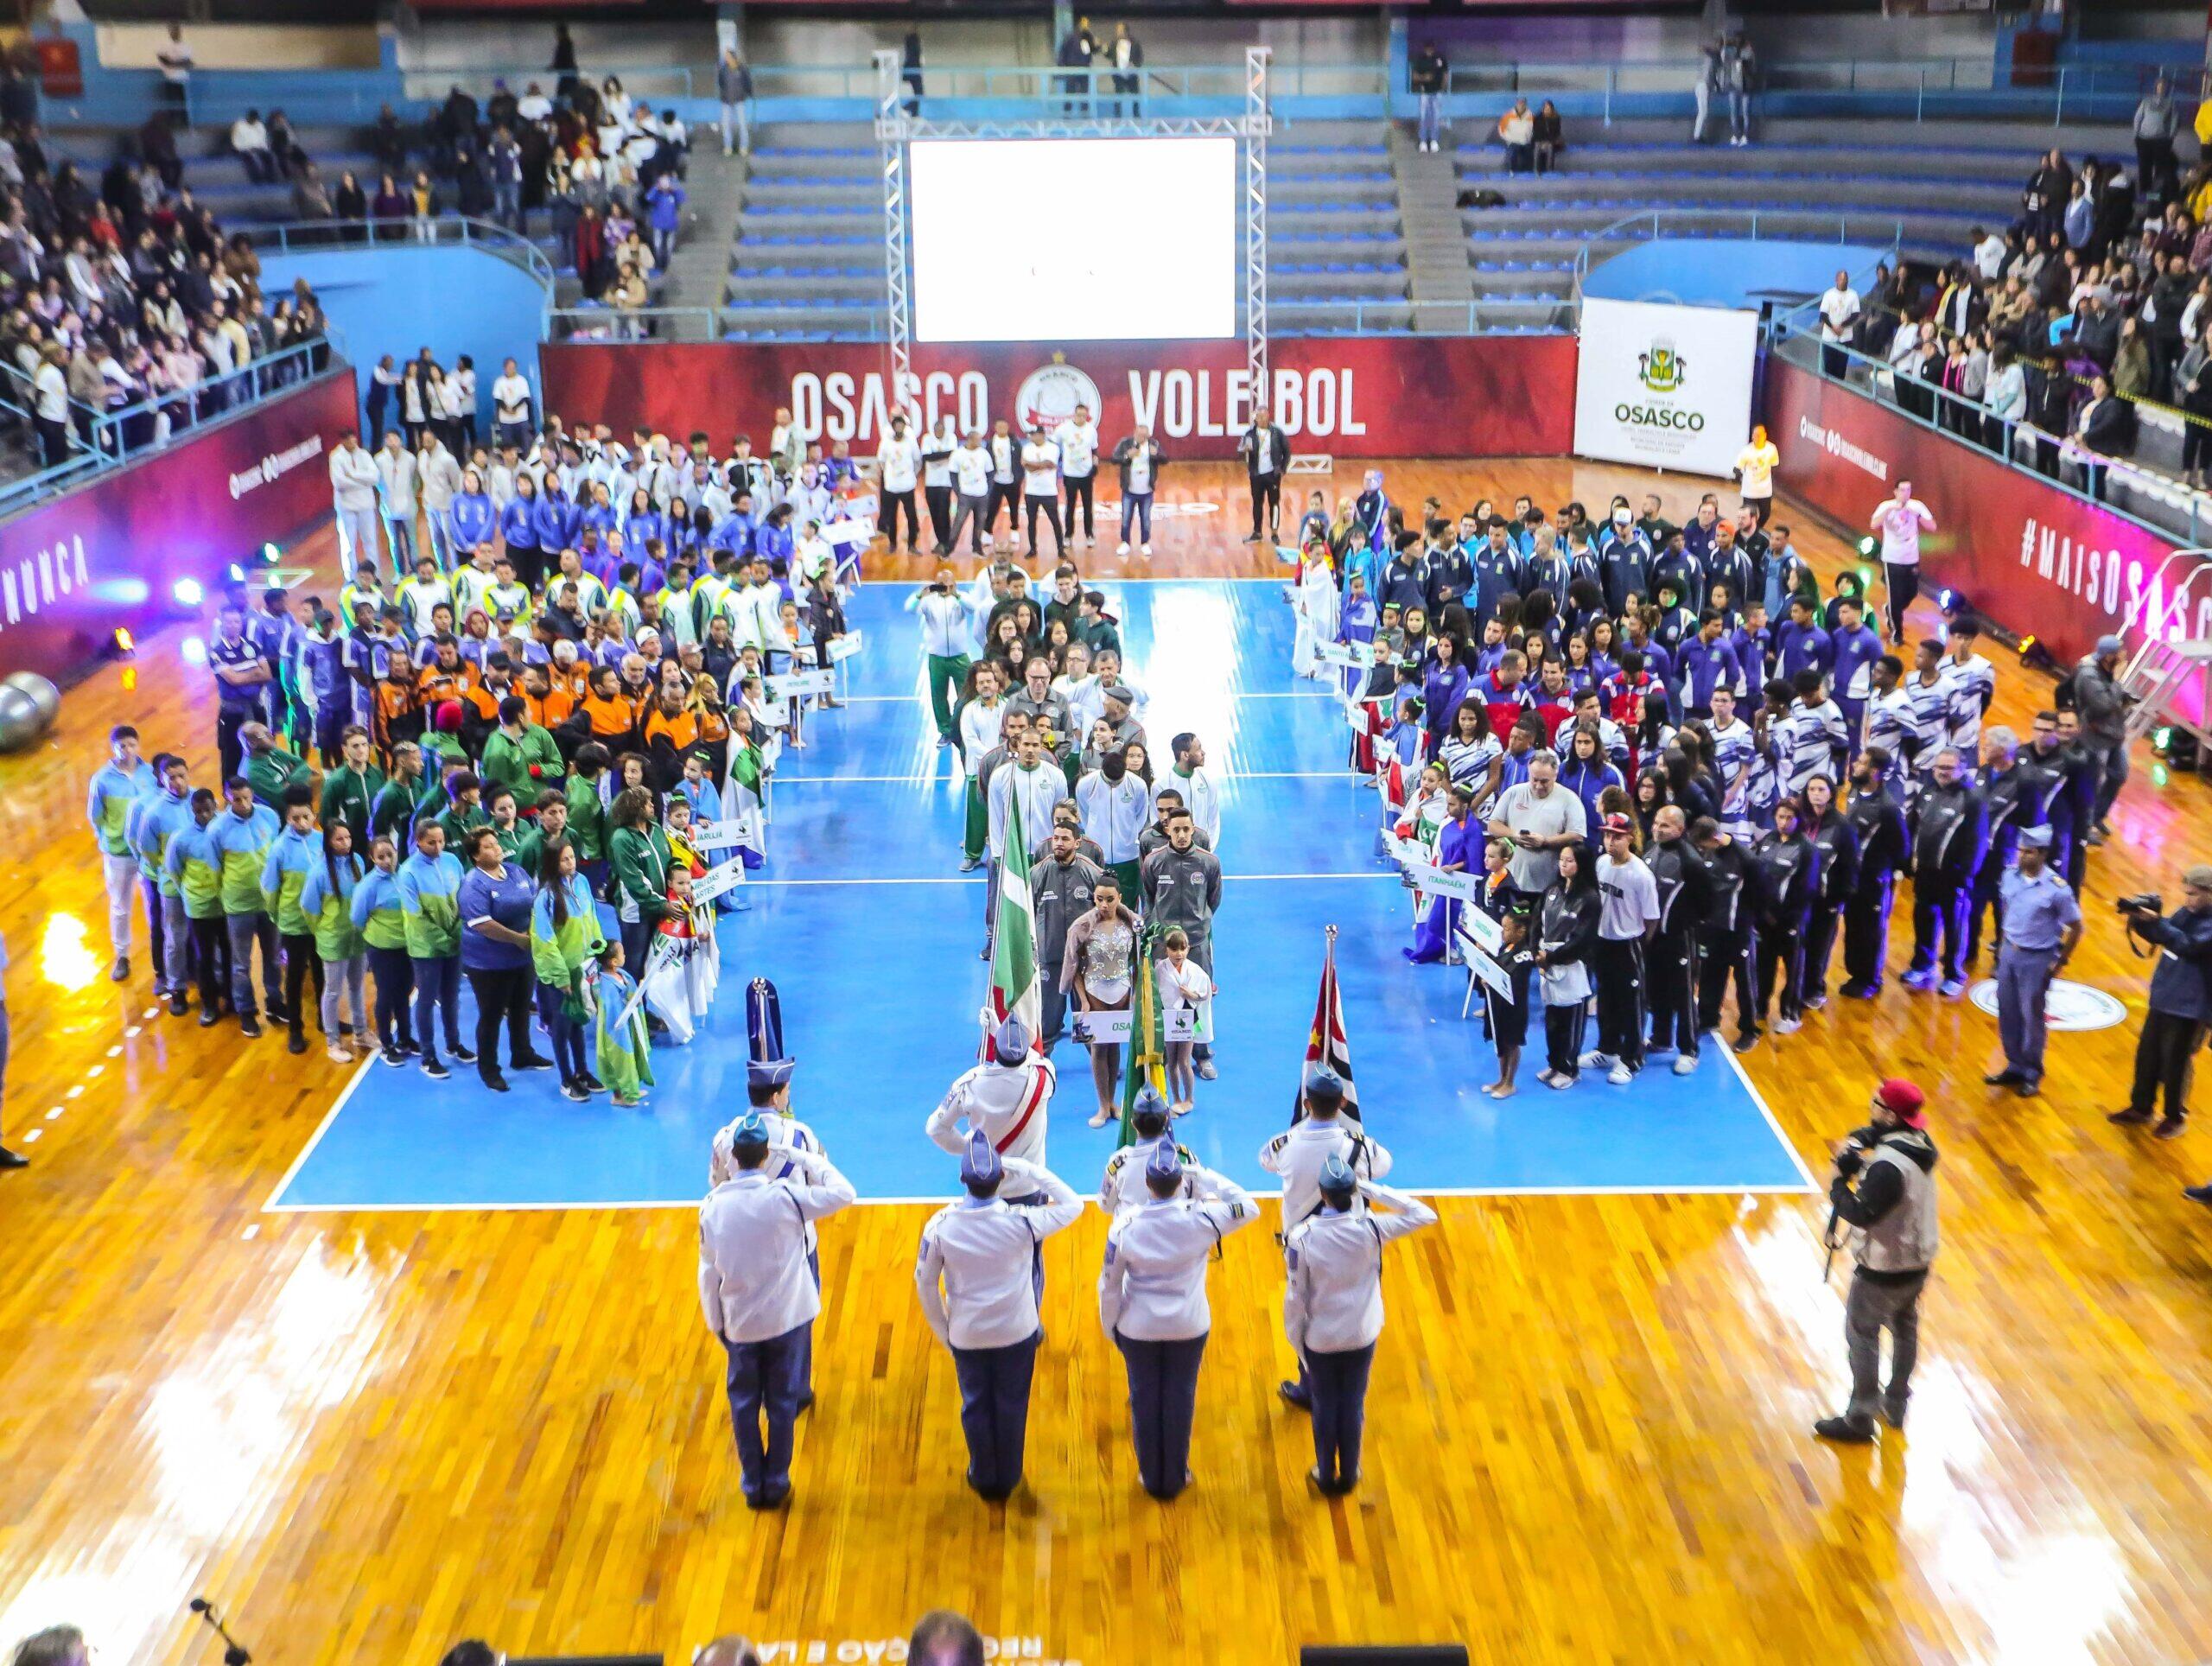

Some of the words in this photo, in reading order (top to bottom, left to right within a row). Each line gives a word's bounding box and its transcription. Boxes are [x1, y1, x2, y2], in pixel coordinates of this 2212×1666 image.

[791, 370, 988, 442] OSASCO
[1614, 404, 1706, 431] OSASCO
[0, 533, 90, 633] NUNCA
